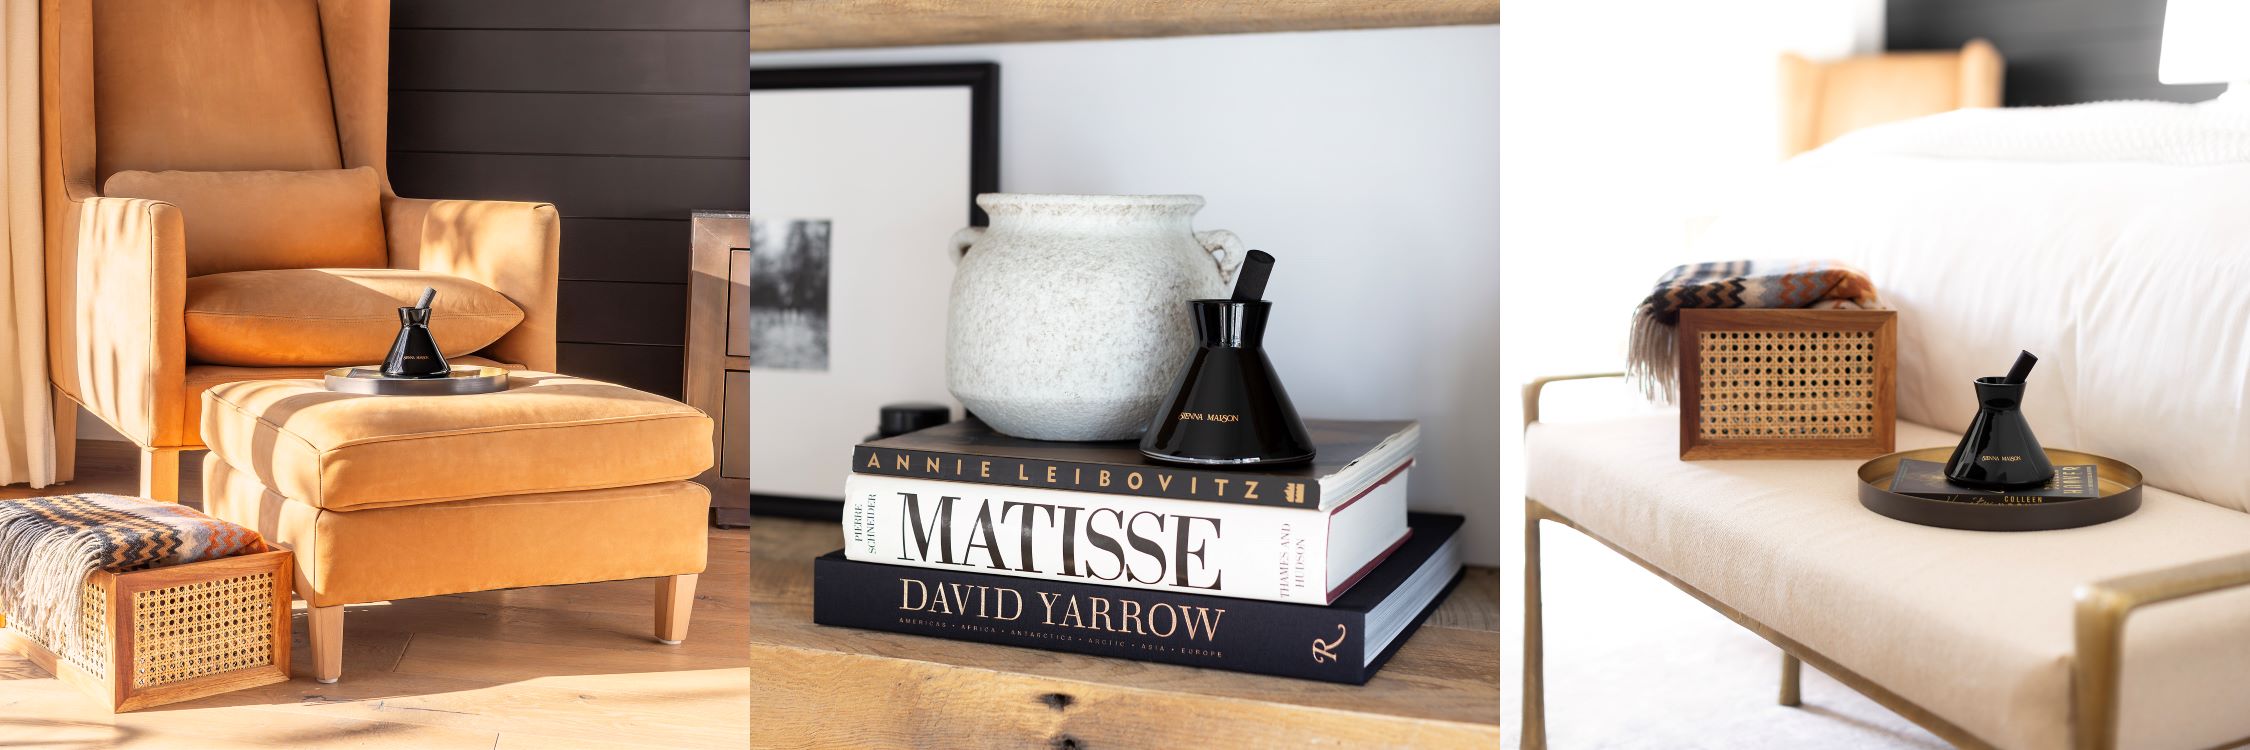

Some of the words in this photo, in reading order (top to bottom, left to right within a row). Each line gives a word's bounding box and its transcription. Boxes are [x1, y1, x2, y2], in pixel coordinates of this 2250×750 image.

[1206, 413, 1239, 423] MAISON
[867, 452, 991, 479] ANNIE
[1019, 463, 1259, 500] LEIBOVITZ
[2004, 495, 2043, 503] COLLEEN
[854, 503, 863, 542] PIERRE
[866, 493, 877, 555] SCHNEIDER
[897, 492, 1222, 591] MATISSE
[1280, 522, 1291, 548] AND
[1279, 552, 1291, 598] THAMES
[1295, 538, 1305, 588] HUDSON
[899, 578, 1023, 621] DAVID
[1036, 591, 1226, 642] YARROW
[899, 617, 947, 628] AMERICAS
[961, 624, 996, 634] AFRICA
[1010, 629, 1073, 642] ANTARCTICA
[1088, 638, 1126, 648] ARCTIC
[1141, 643, 1166, 652] ASIA
[1181, 647, 1223, 658] EUROPE
